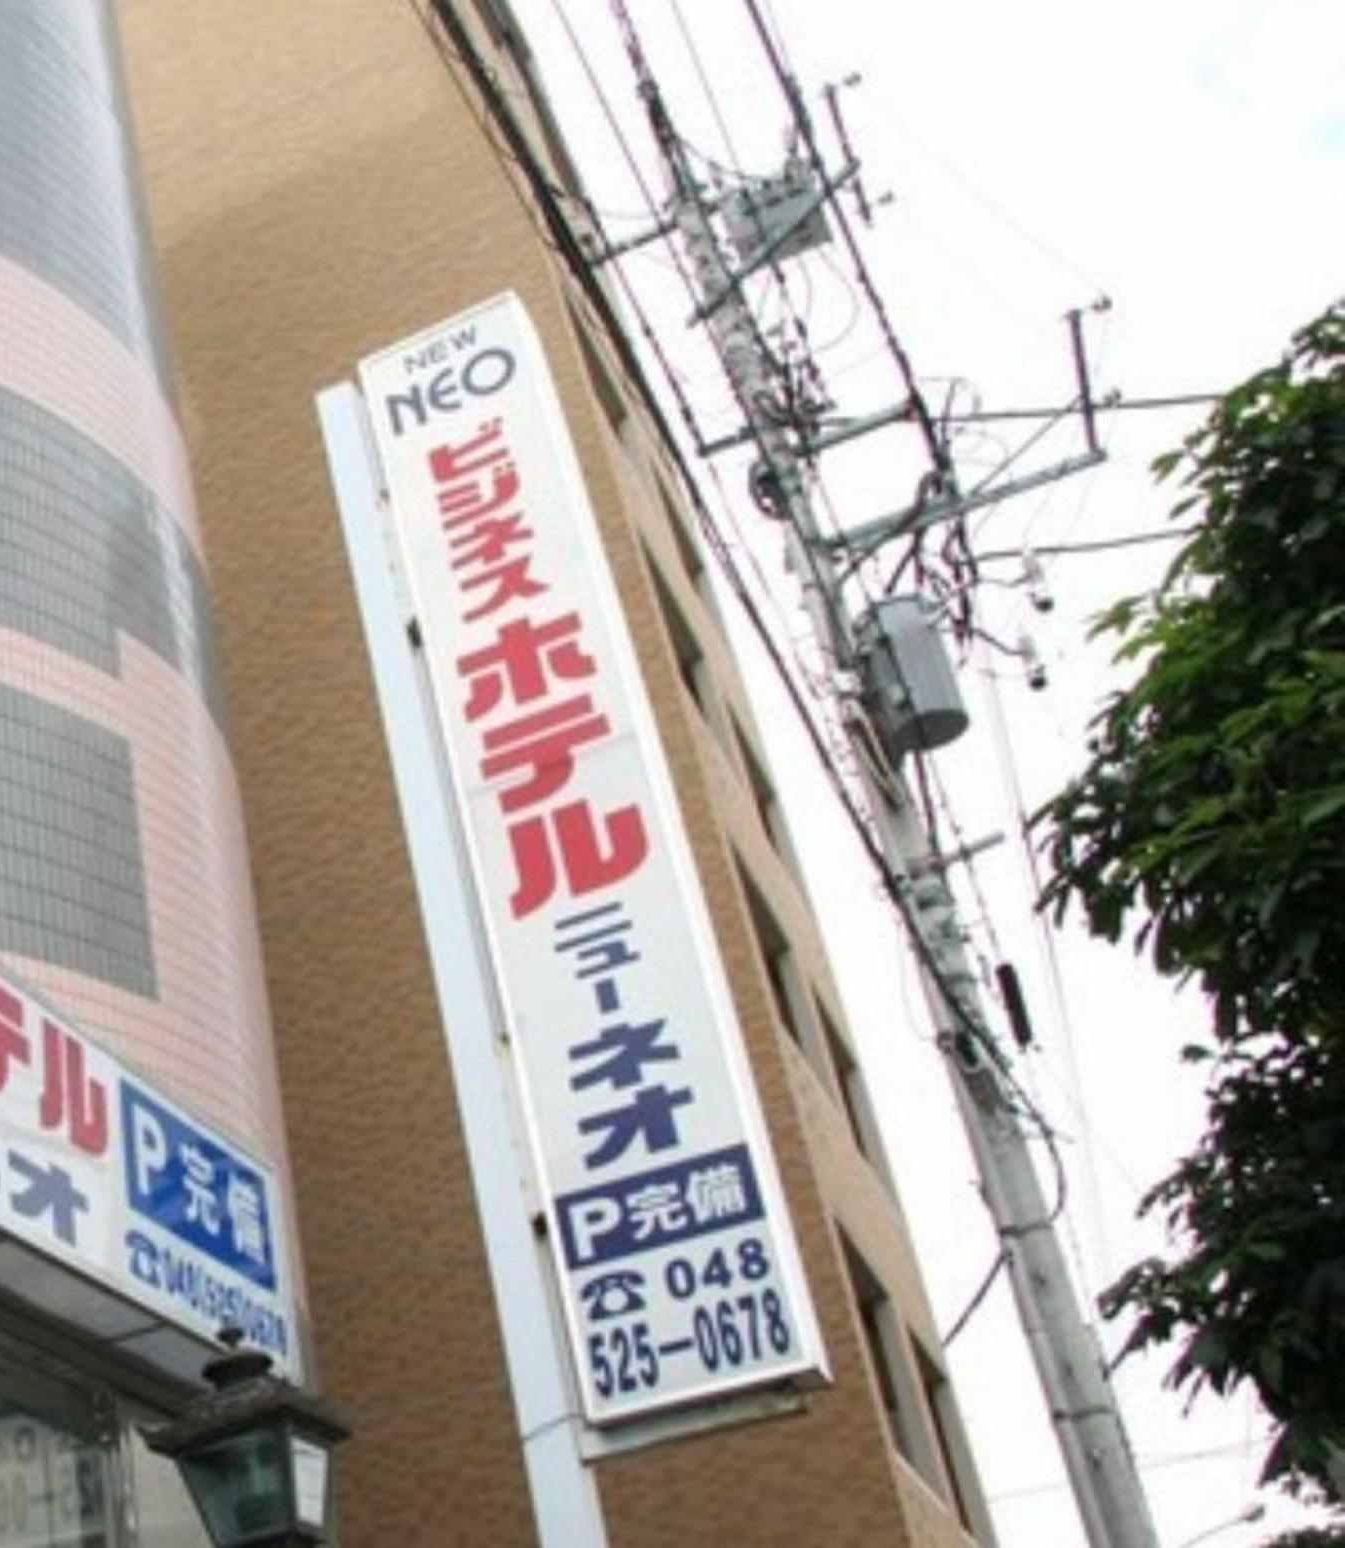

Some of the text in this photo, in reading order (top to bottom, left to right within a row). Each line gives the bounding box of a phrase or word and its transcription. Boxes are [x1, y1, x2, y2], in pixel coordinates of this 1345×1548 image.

[385, 347, 516, 436] NEO
[405, 326, 477, 374] NEW
[428, 416, 552, 624] ビジネス
[456, 610, 648, 921] ホテル
[665, 1238, 769, 1300] 048
